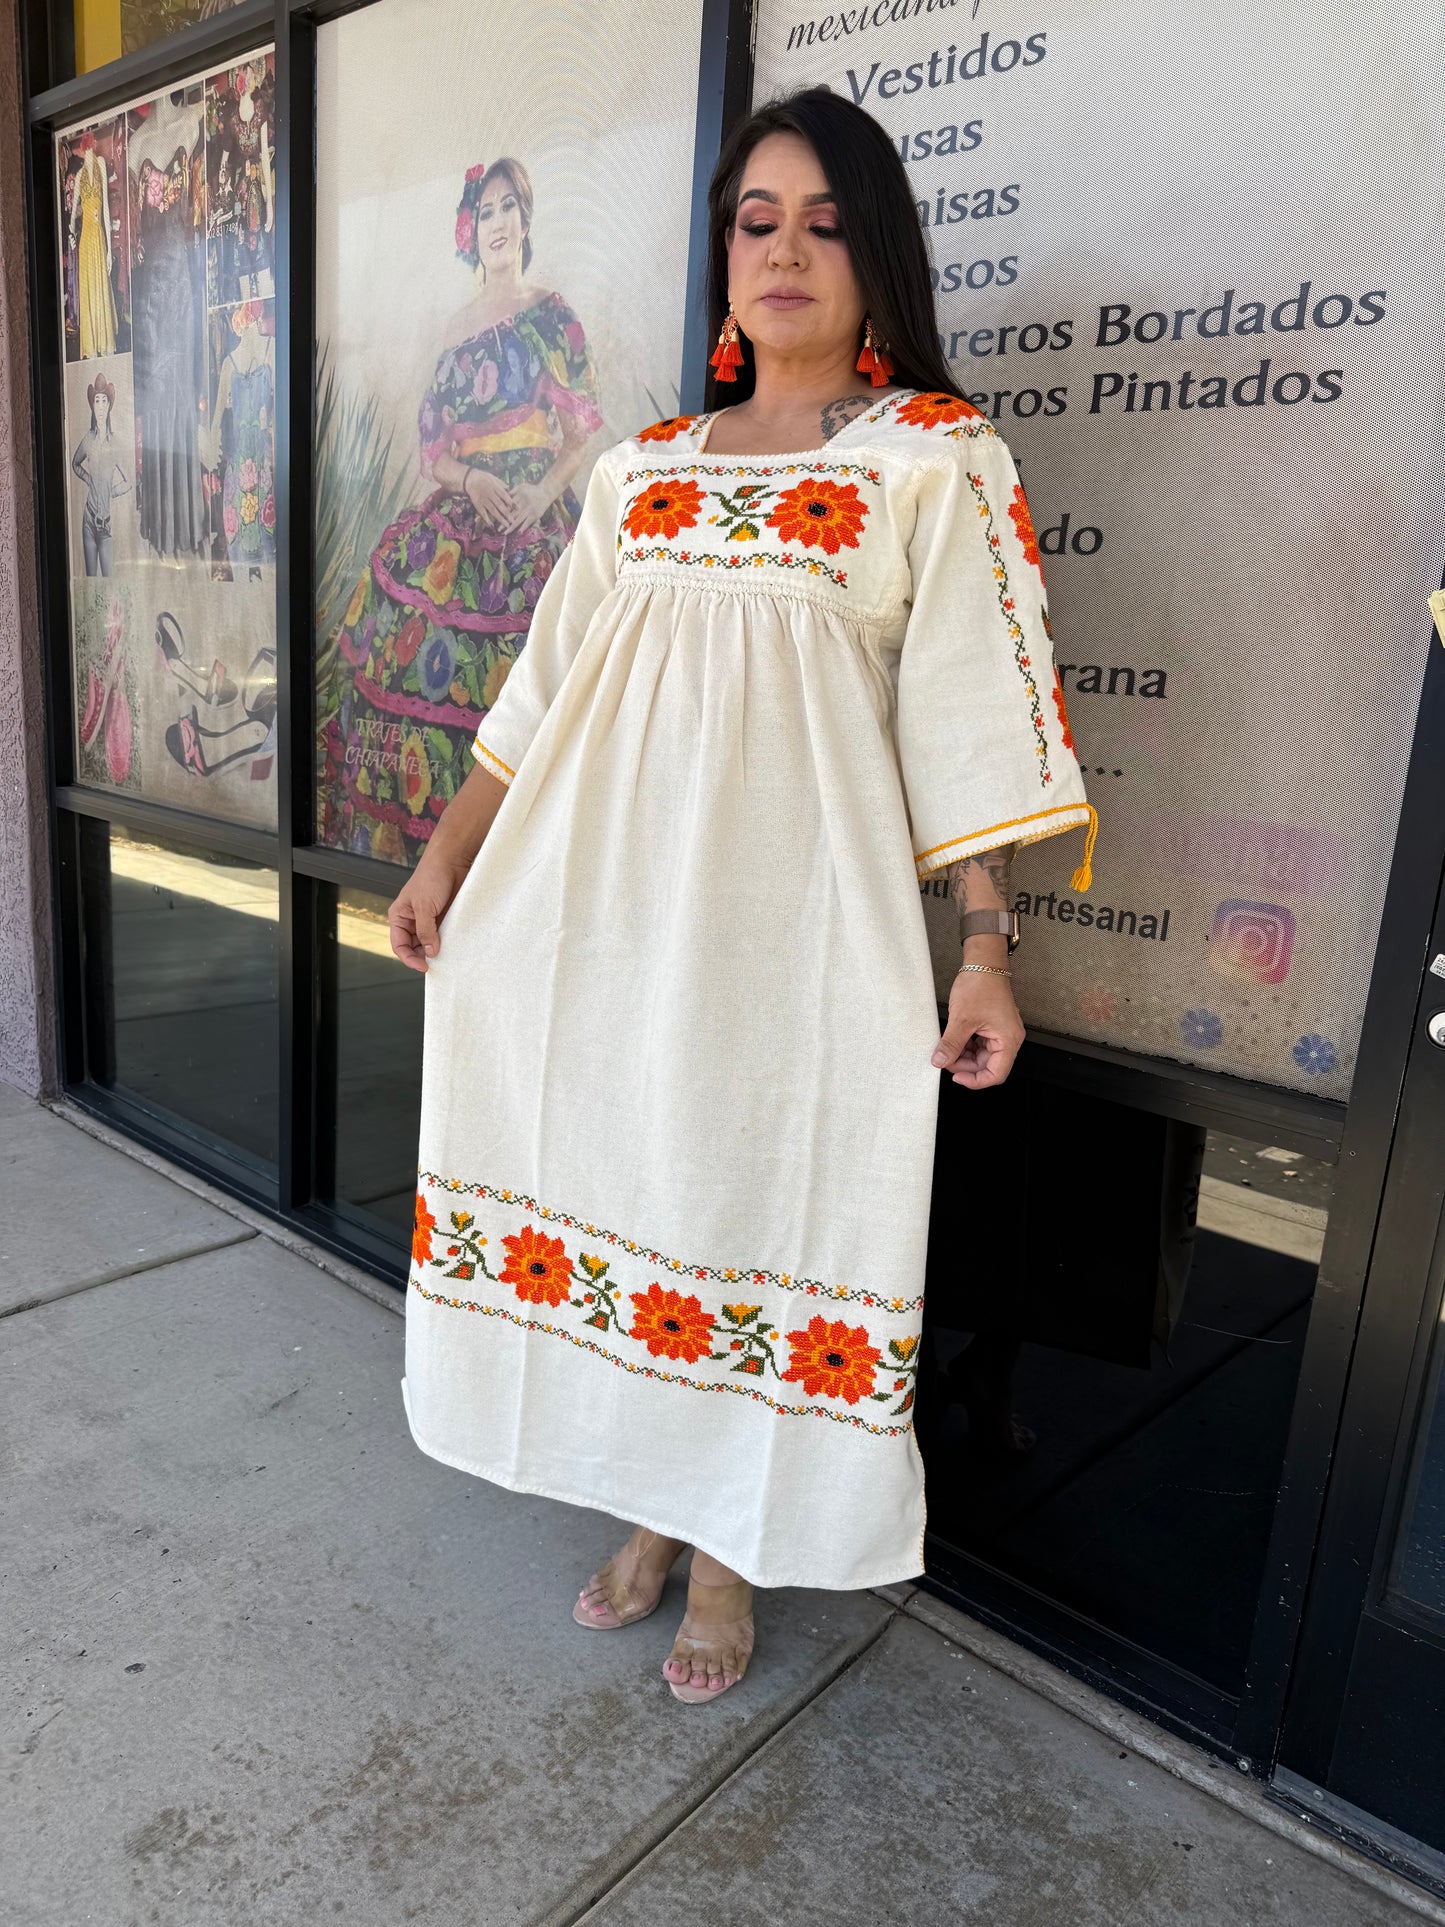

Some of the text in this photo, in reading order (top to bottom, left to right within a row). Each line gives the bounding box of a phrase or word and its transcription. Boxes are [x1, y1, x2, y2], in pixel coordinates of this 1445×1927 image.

[786, 0, 966, 51] mexican
[845, 32, 1048, 106] Vestidos
[1095, 281, 1388, 347] Bordados
[1088, 358, 1344, 415] Pintados
[356, 718, 431, 747] TRAJES DE
[1014, 891, 1170, 942] artesanal
